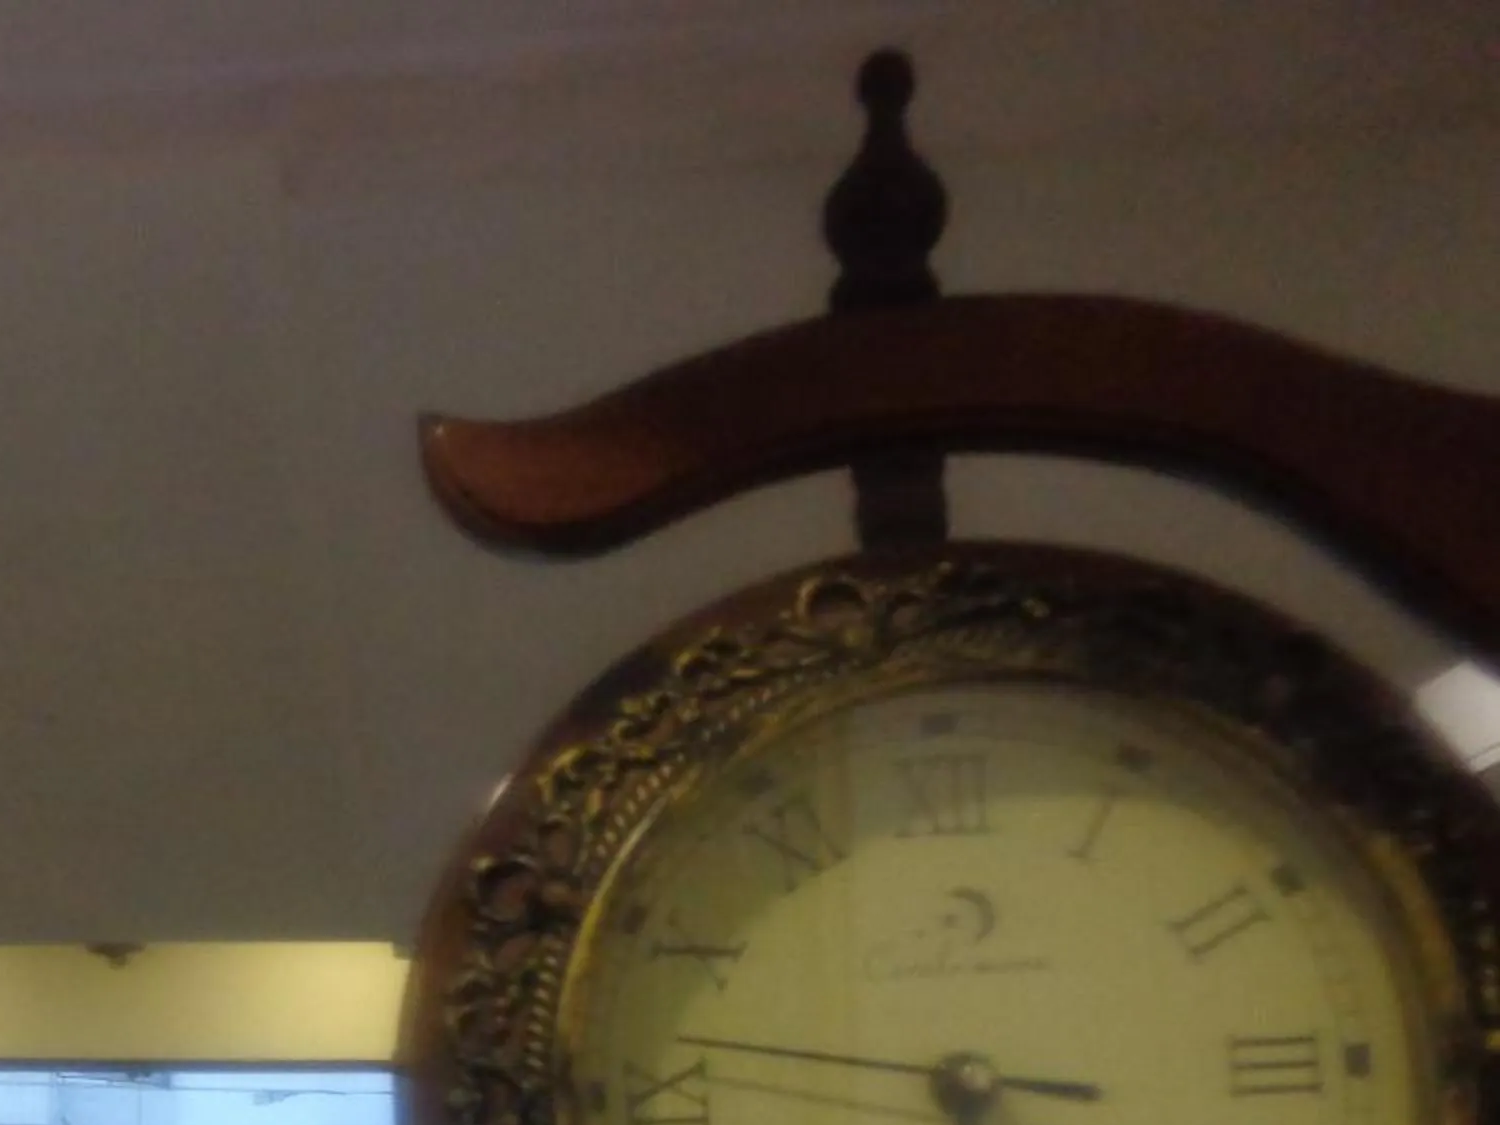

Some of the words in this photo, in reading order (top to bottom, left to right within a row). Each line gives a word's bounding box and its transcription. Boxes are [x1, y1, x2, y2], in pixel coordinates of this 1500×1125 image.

[894, 752, 992, 838] XII
[743, 793, 848, 892] XI
[650, 905, 748, 992] X
[1164, 883, 1272, 962] II
[1227, 1034, 1324, 1096] III
